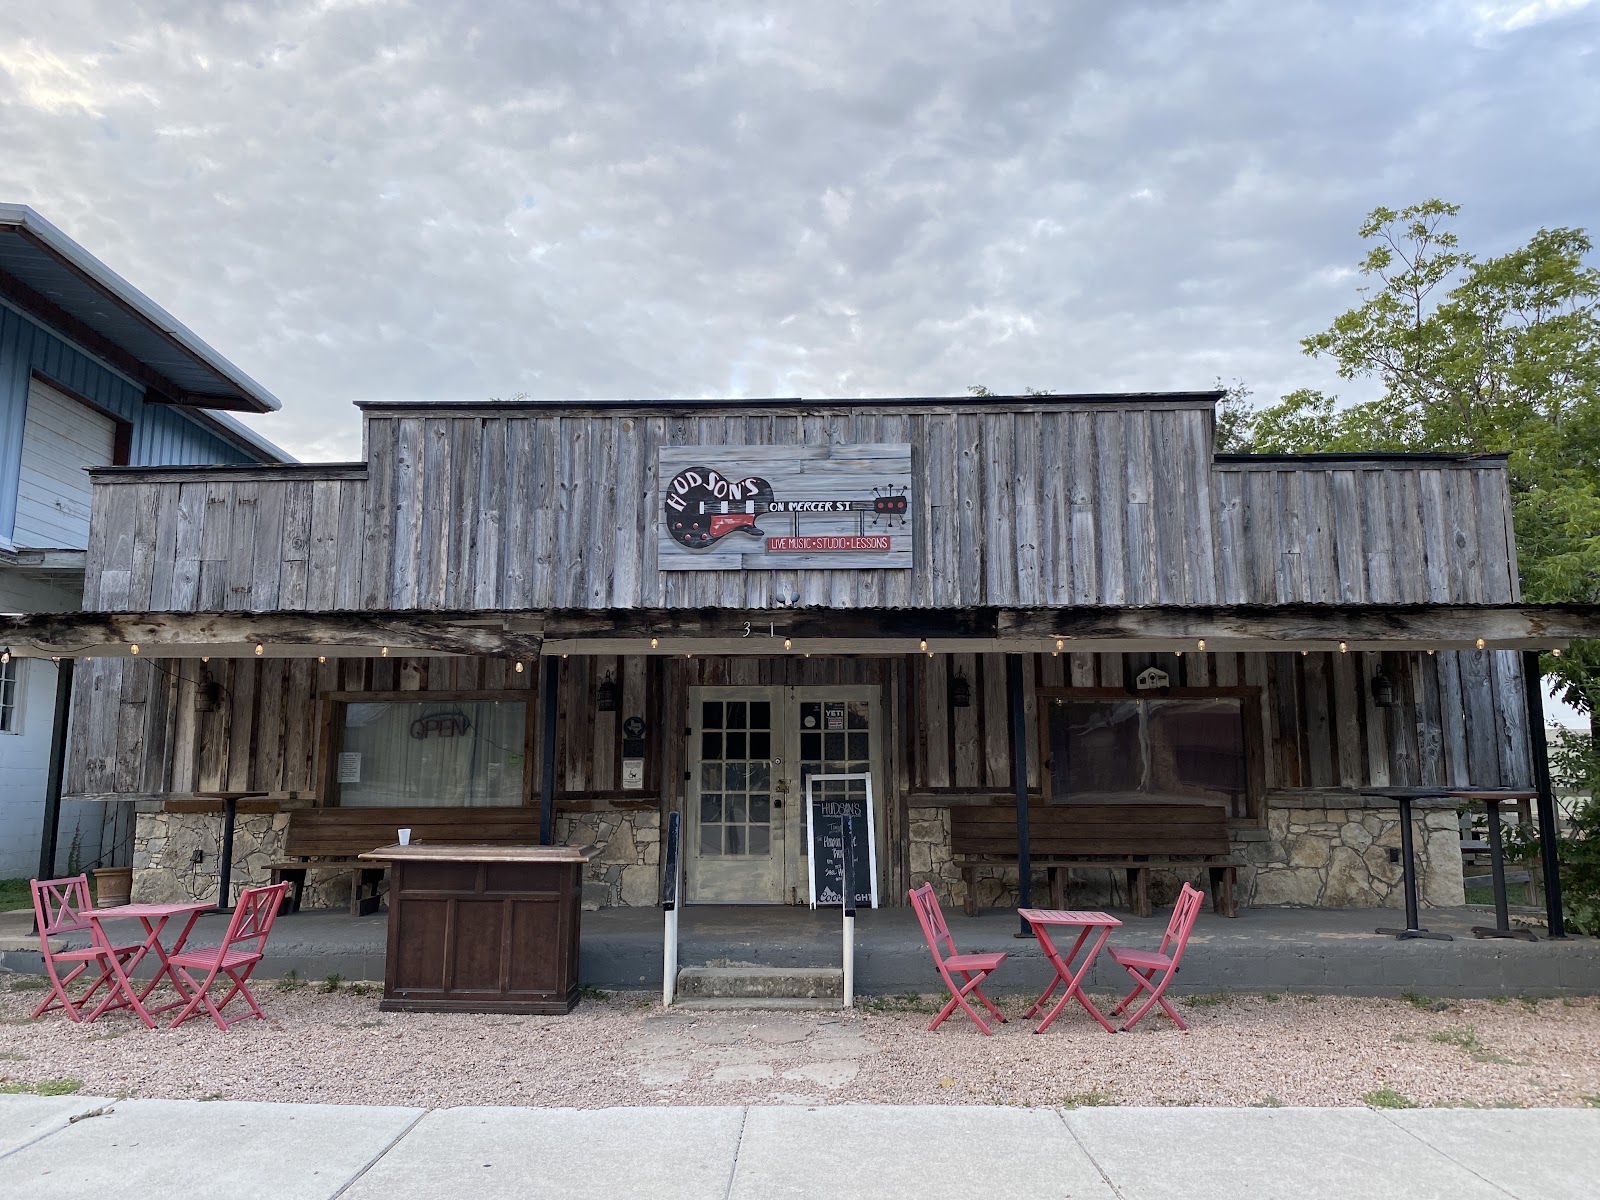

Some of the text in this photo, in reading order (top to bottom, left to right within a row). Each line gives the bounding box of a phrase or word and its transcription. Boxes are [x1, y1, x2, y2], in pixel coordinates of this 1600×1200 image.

[666, 471, 759, 512] HUDSON'S
[769, 501, 851, 512] ON MERCER ST
[771, 538, 787, 549] LIVE
[850, 536, 888, 549] LESSONS
[825, 709, 844, 717] YETI
[410, 717, 466, 740] OPEN
